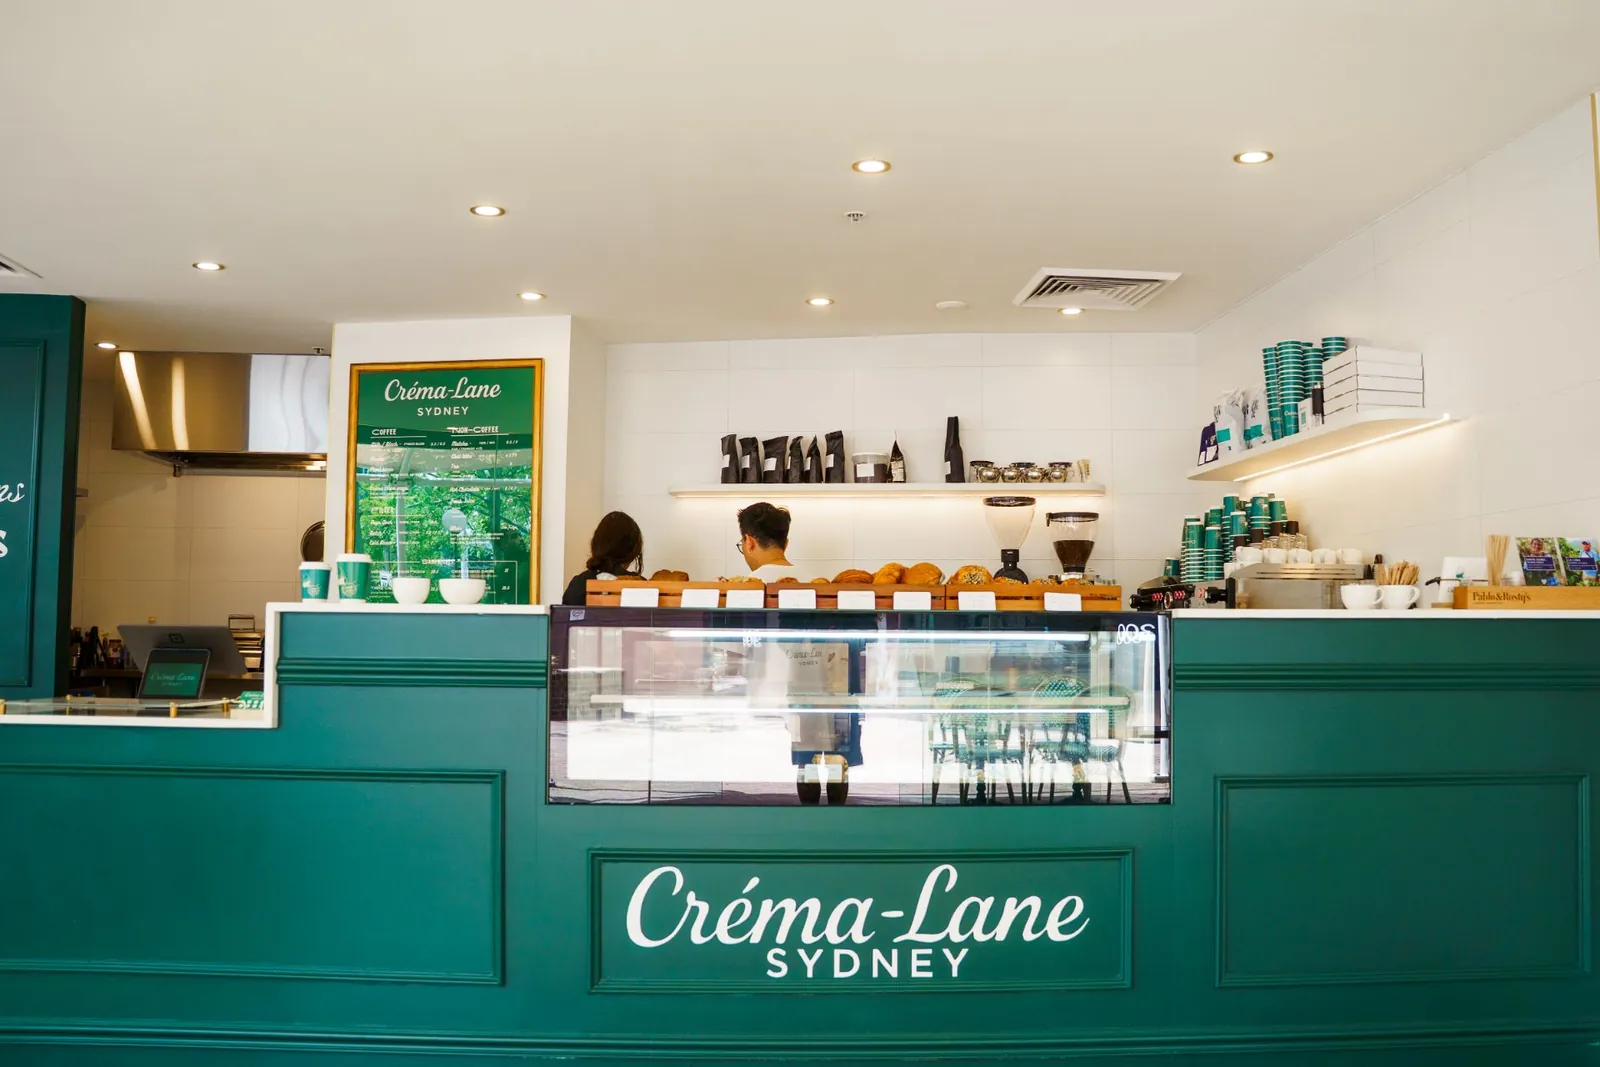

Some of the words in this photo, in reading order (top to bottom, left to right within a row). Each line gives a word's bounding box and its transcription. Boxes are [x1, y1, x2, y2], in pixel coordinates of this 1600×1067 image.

[385, 377, 501, 401] Créma-Lane
[418, 407, 468, 416] SYDNEY
[371, 428, 397, 436] COFFEE
[627, 864, 1089, 947] Créma-Lane
[767, 948, 968, 977] SYDNEY
